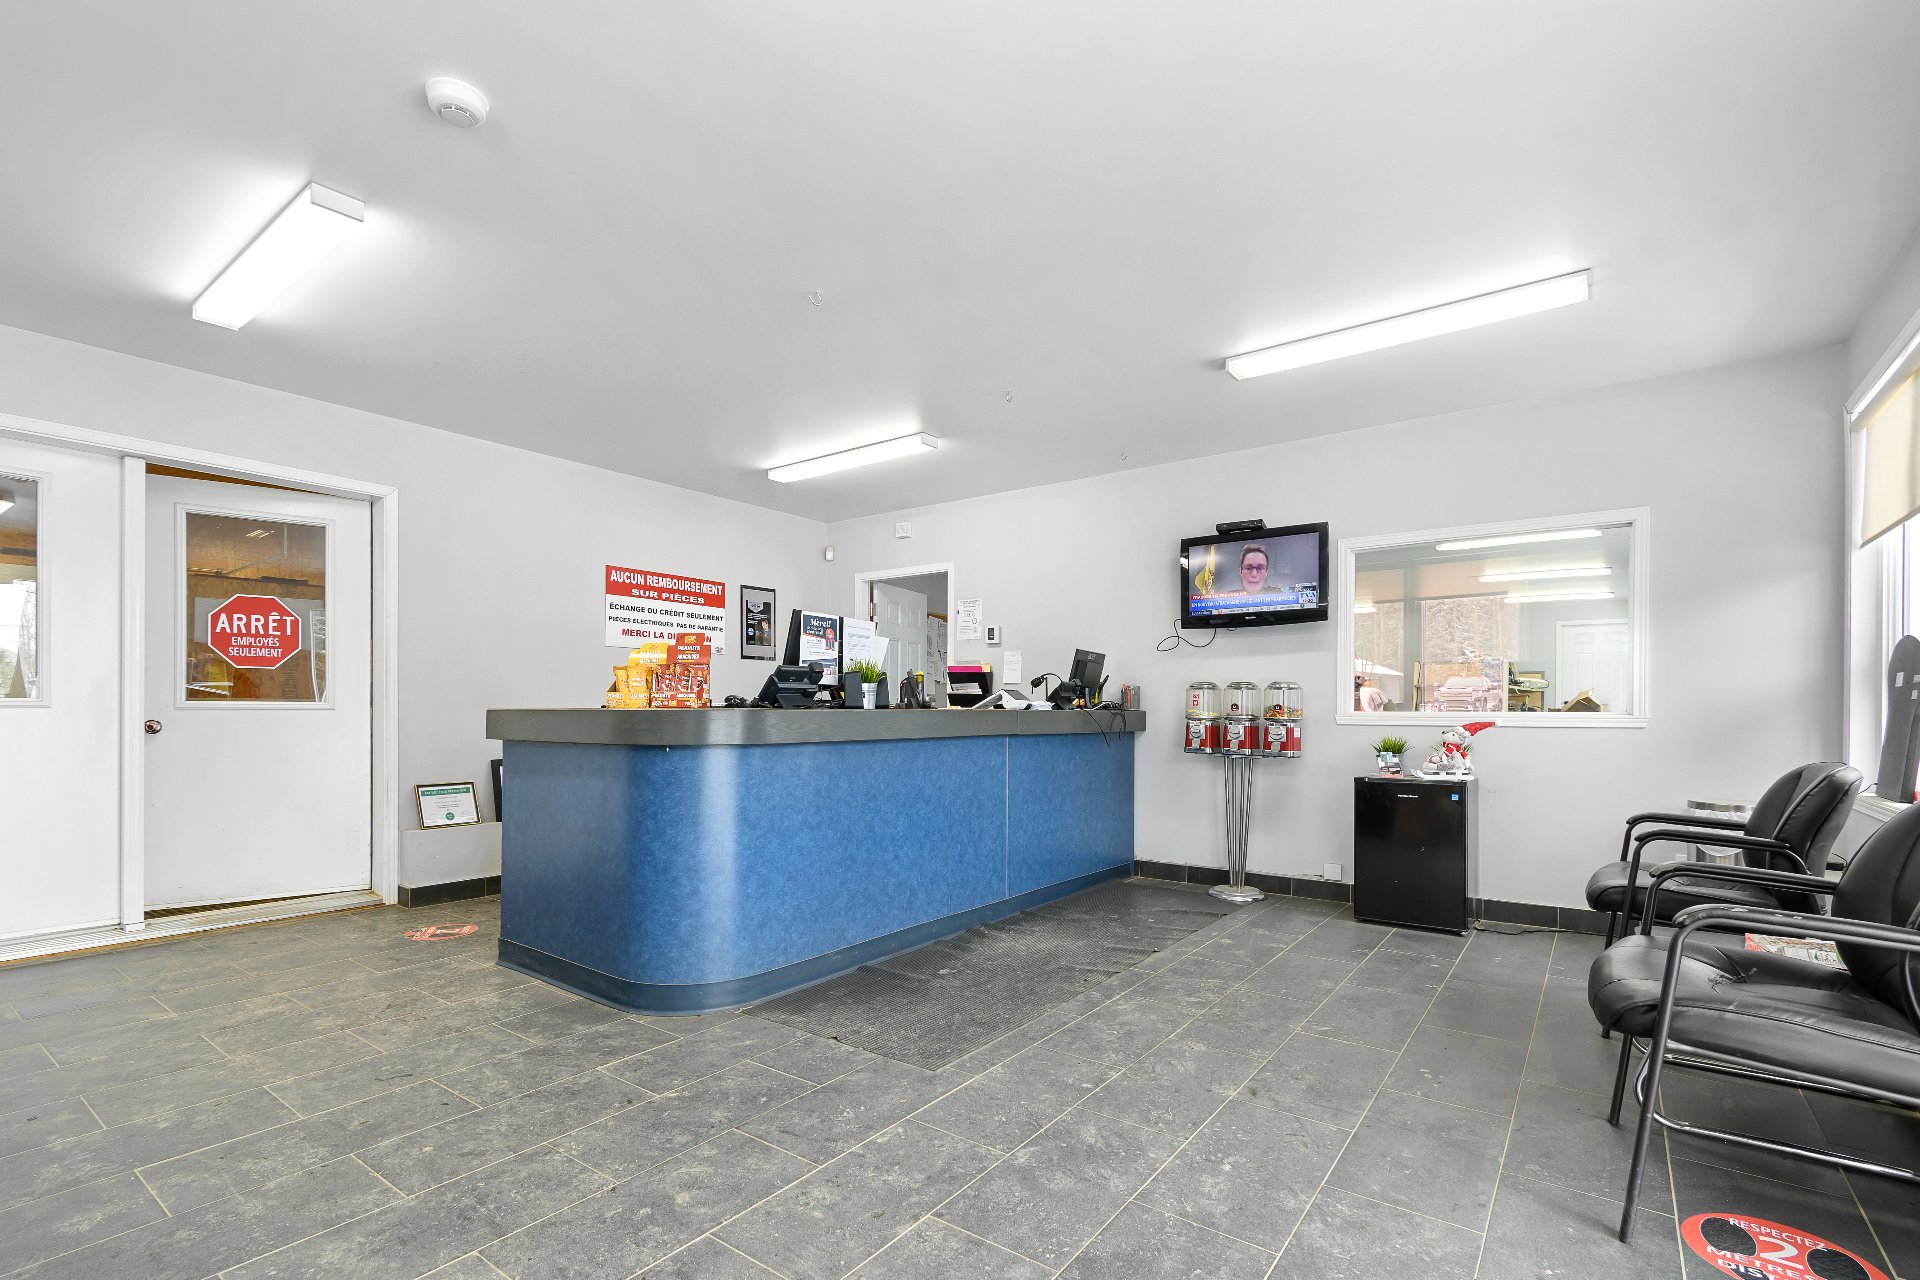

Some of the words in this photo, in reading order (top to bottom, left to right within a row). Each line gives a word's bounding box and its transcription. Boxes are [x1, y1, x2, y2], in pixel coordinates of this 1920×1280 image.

[610, 570, 645, 586] AUCUN
[646, 575, 723, 596] REMBOURSEMENT
[631, 588, 659, 598] SUR
[661, 592, 705, 604] PIÈCES
[609, 601, 646, 613] ÉCHANGE
[647, 607, 658, 615] OU
[659, 608, 685, 618] CRÉDIT
[686, 612, 724, 622] SEULEMENT
[215, 612, 295, 635] ARRÊT
[621, 628, 651, 638] MERCI
[653, 631, 665, 640] LA
[676, 622, 688, 630] PAS
[697, 624, 724, 633] GARANTIE
[231, 635, 280, 647] EMPLOYÉS
[228, 646, 283, 658] SEULEMENT
[1729, 1217, 1829, 1252] RESPECTEZ
[1758, 1235, 1804, 1270] 2
[1717, 1257, 1789, 1280] DIST
